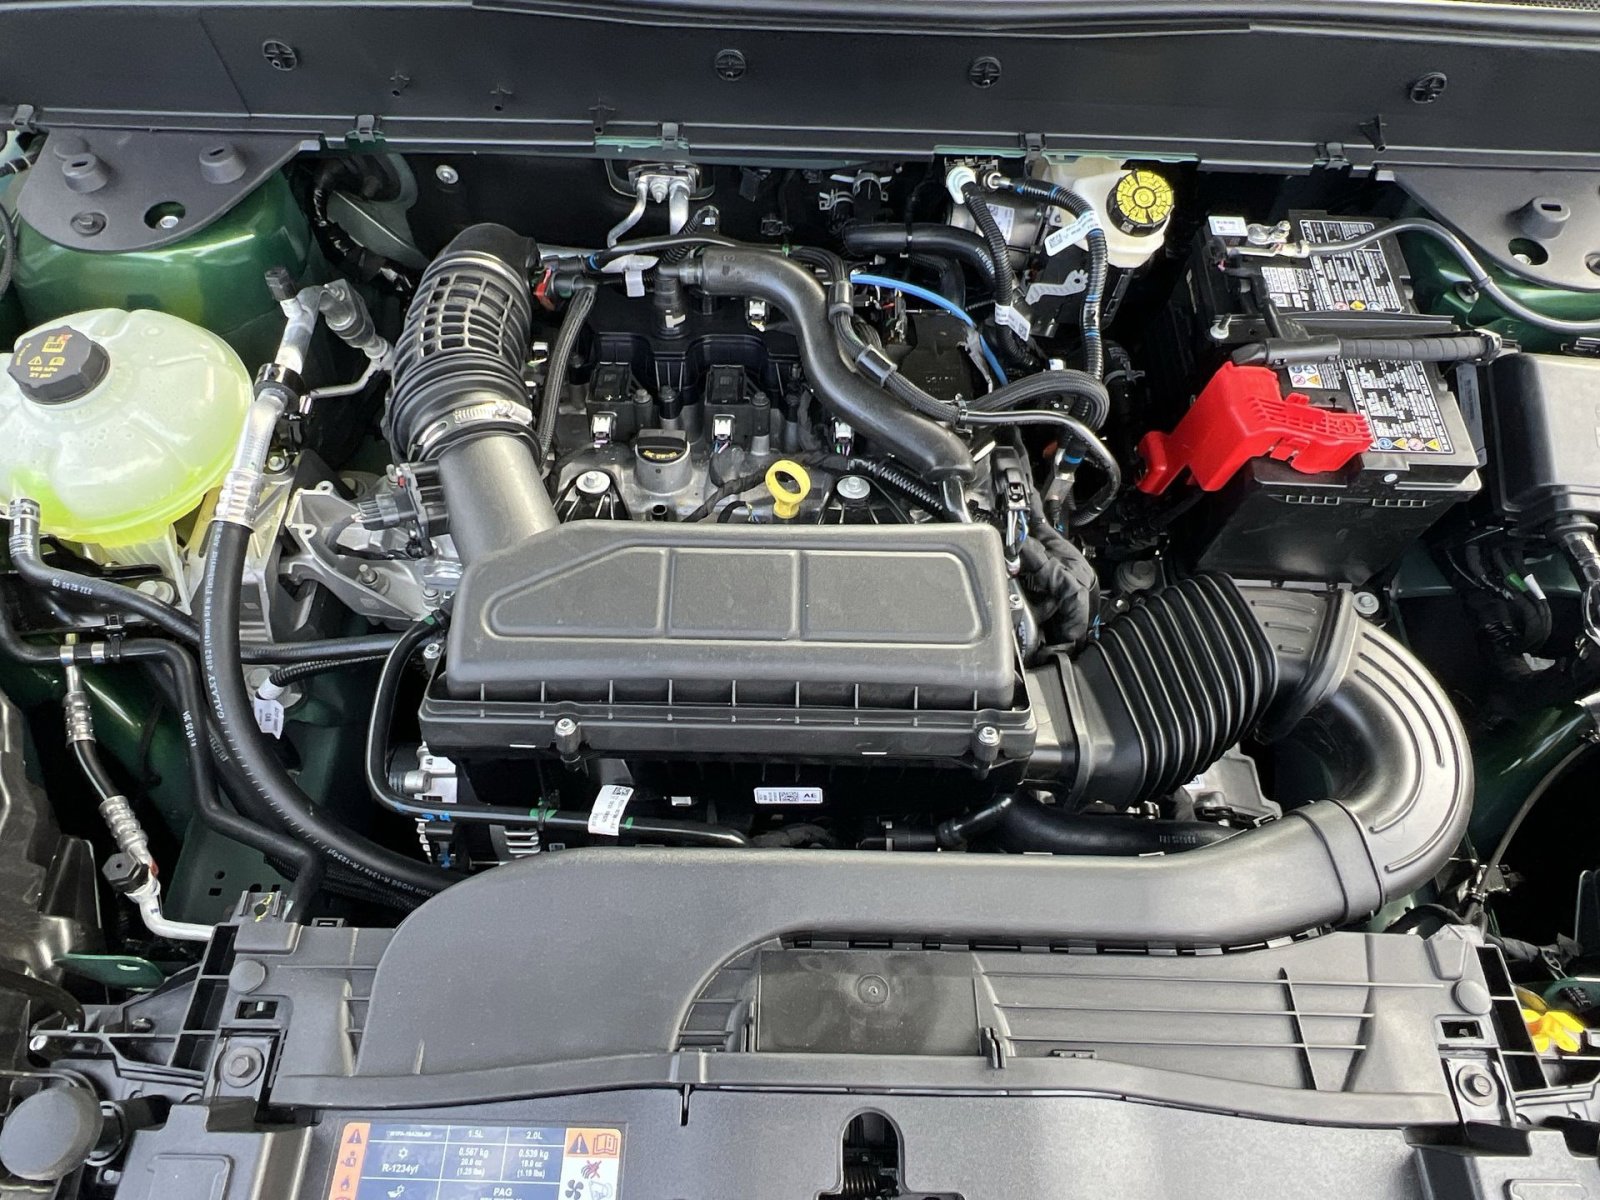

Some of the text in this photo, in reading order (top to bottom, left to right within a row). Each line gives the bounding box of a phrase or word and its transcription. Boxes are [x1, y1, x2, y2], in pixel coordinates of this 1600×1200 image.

[208, 673, 225, 719] GALAXY
[326, 848, 360, 870] R-1234yf
[468, 1130, 484, 1138] 1.5L
[526, 1131, 543, 1140] 2.0L
[479, 1148, 489, 1158] kg
[539, 1150, 549, 1160] kg
[382, 1163, 420, 1175] R-1234yf
[493, 1188, 513, 1197] PAG
